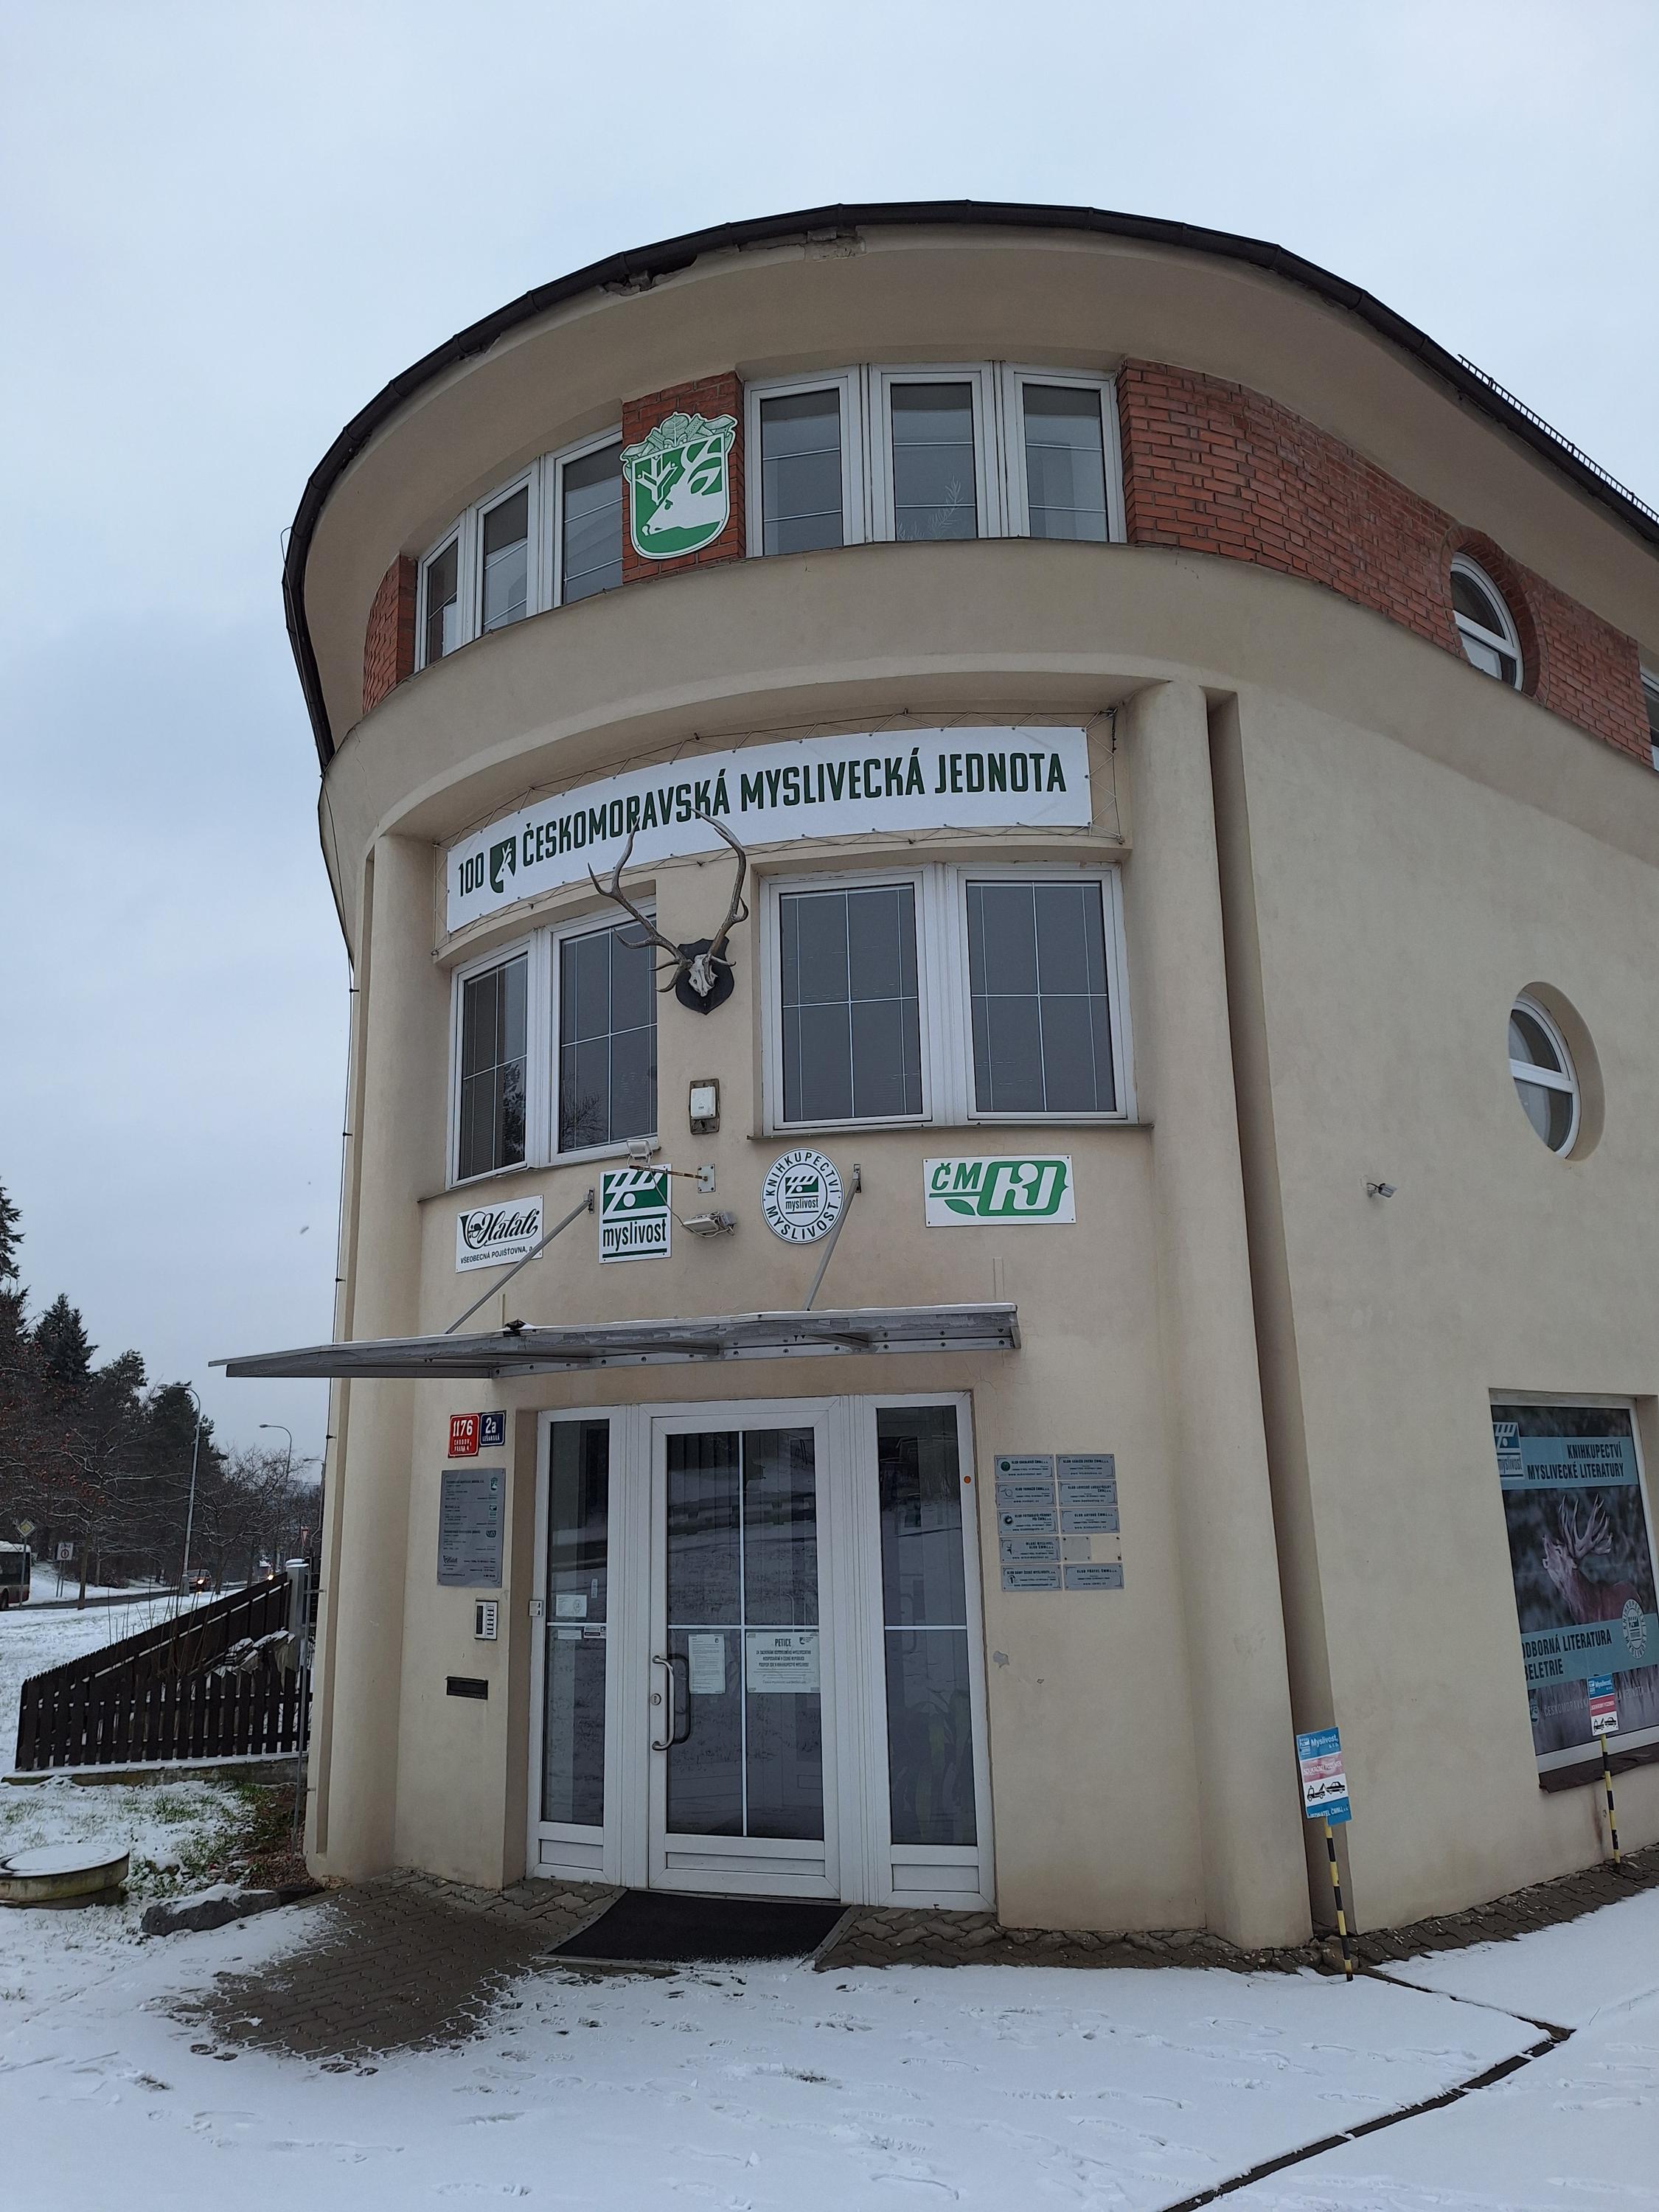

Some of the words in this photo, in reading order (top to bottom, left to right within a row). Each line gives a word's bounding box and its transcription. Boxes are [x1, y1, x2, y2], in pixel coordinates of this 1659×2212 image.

[458, 852, 484, 897] 100
[522, 768, 731, 867] ČESKOMORAVSKÁ
[740, 747, 925, 812] MYSLIVECKÁ
[934, 752, 1067, 794] JEDNOTA
[765, 1152, 841, 1196] KNIHKUPECTVÍ
[785, 1197, 818, 1211] myslivost
[766, 1202, 838, 1239] MYSLIVOST
[603, 1218, 667, 1251] myslivost
[460, 1252, 490, 1265] VŠEOBECNÁ
[453, 1419, 473, 1437] 1176
[485, 1416, 496, 1434] 2a
[1567, 1441, 1623, 1459] KNIHKUPECTVÍ
[1527, 1461, 1579, 1480] MYSLIVECKÉ
[1579, 1462, 1624, 1478] LITERATURY
[774, 1638, 791, 1647] PETICE
[1562, 1628, 1613, 1652] LITERATURA
